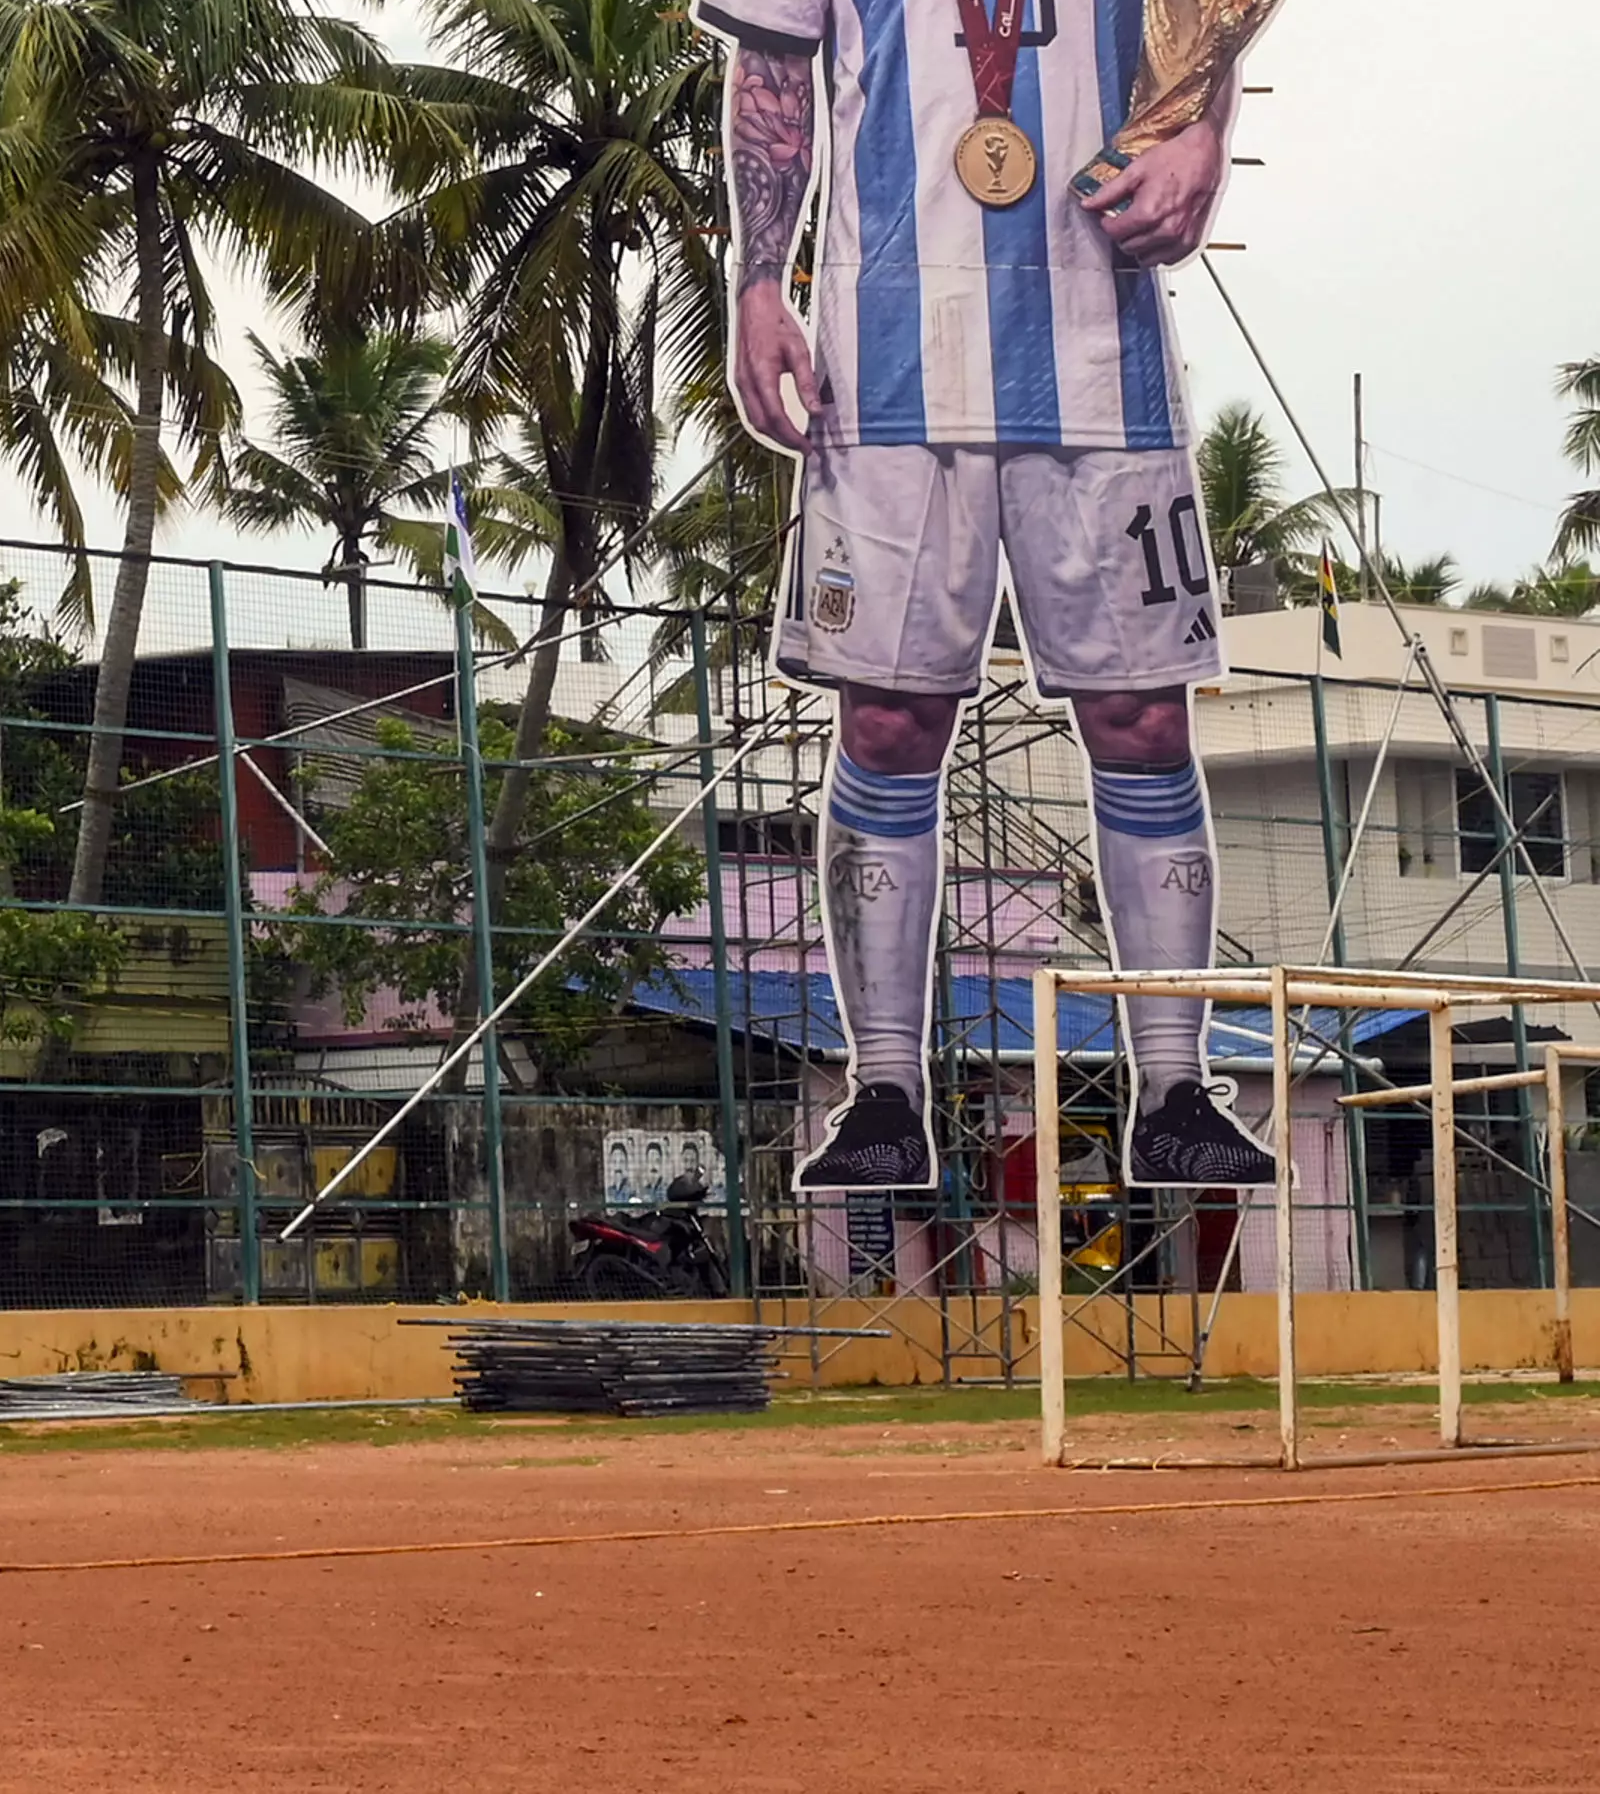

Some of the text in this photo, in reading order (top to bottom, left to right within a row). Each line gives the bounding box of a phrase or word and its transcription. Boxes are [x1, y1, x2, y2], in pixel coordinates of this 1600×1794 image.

[1125, 493, 1211, 606] 10
[836, 858, 900, 903] AFA
[1160, 856, 1212, 898] AFA
